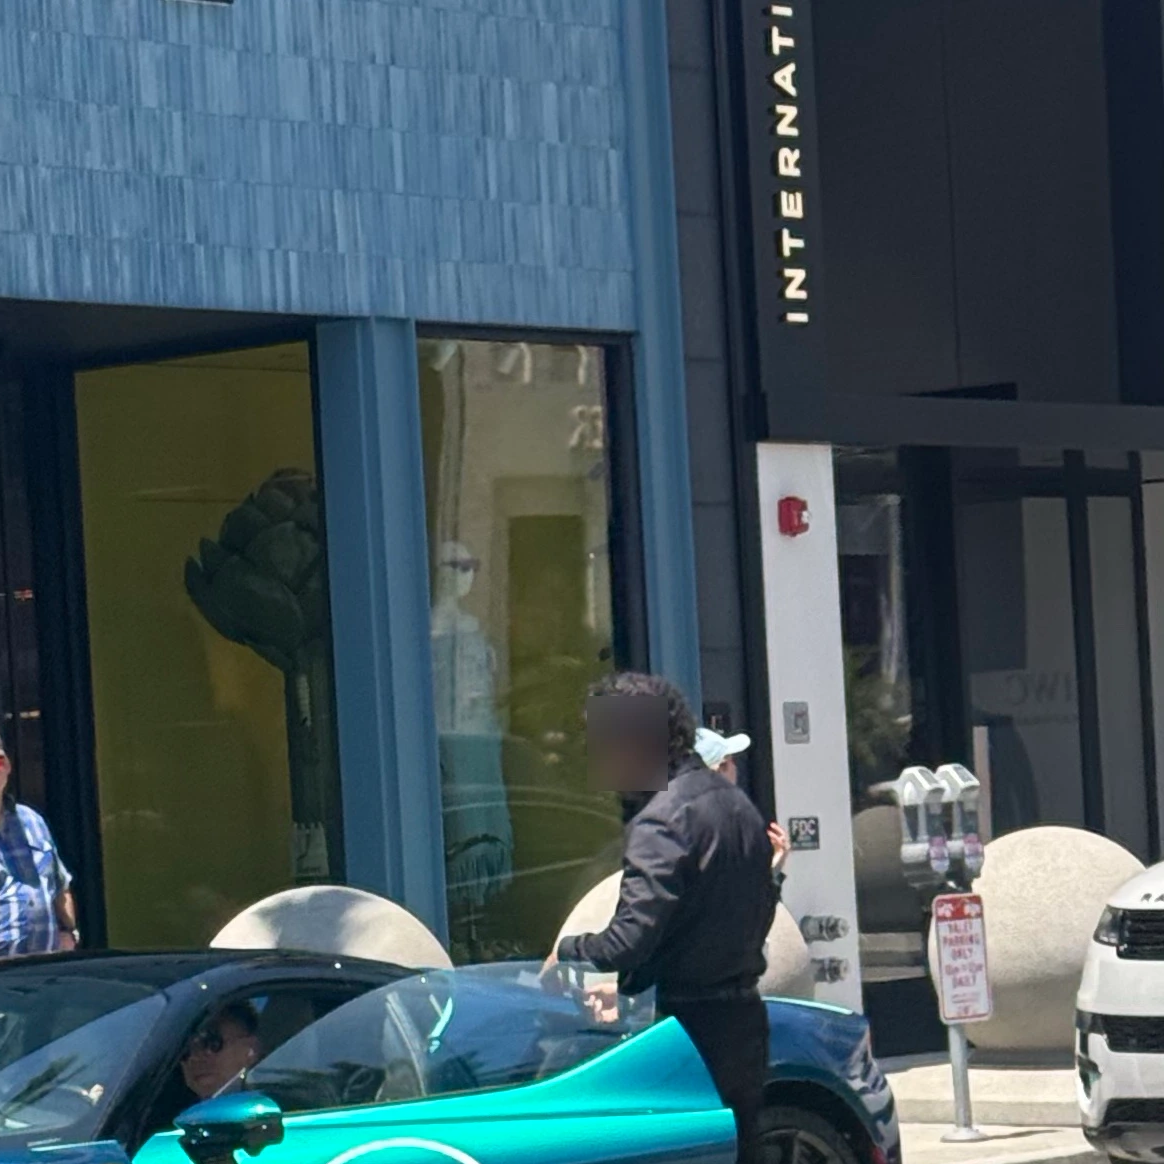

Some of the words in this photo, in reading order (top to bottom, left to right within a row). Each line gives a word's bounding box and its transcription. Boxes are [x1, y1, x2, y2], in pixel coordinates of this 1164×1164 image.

[770, 5, 809, 323] INTERNATI
[791, 820, 816, 835] FDC
[942, 934, 981, 947] PARKING
